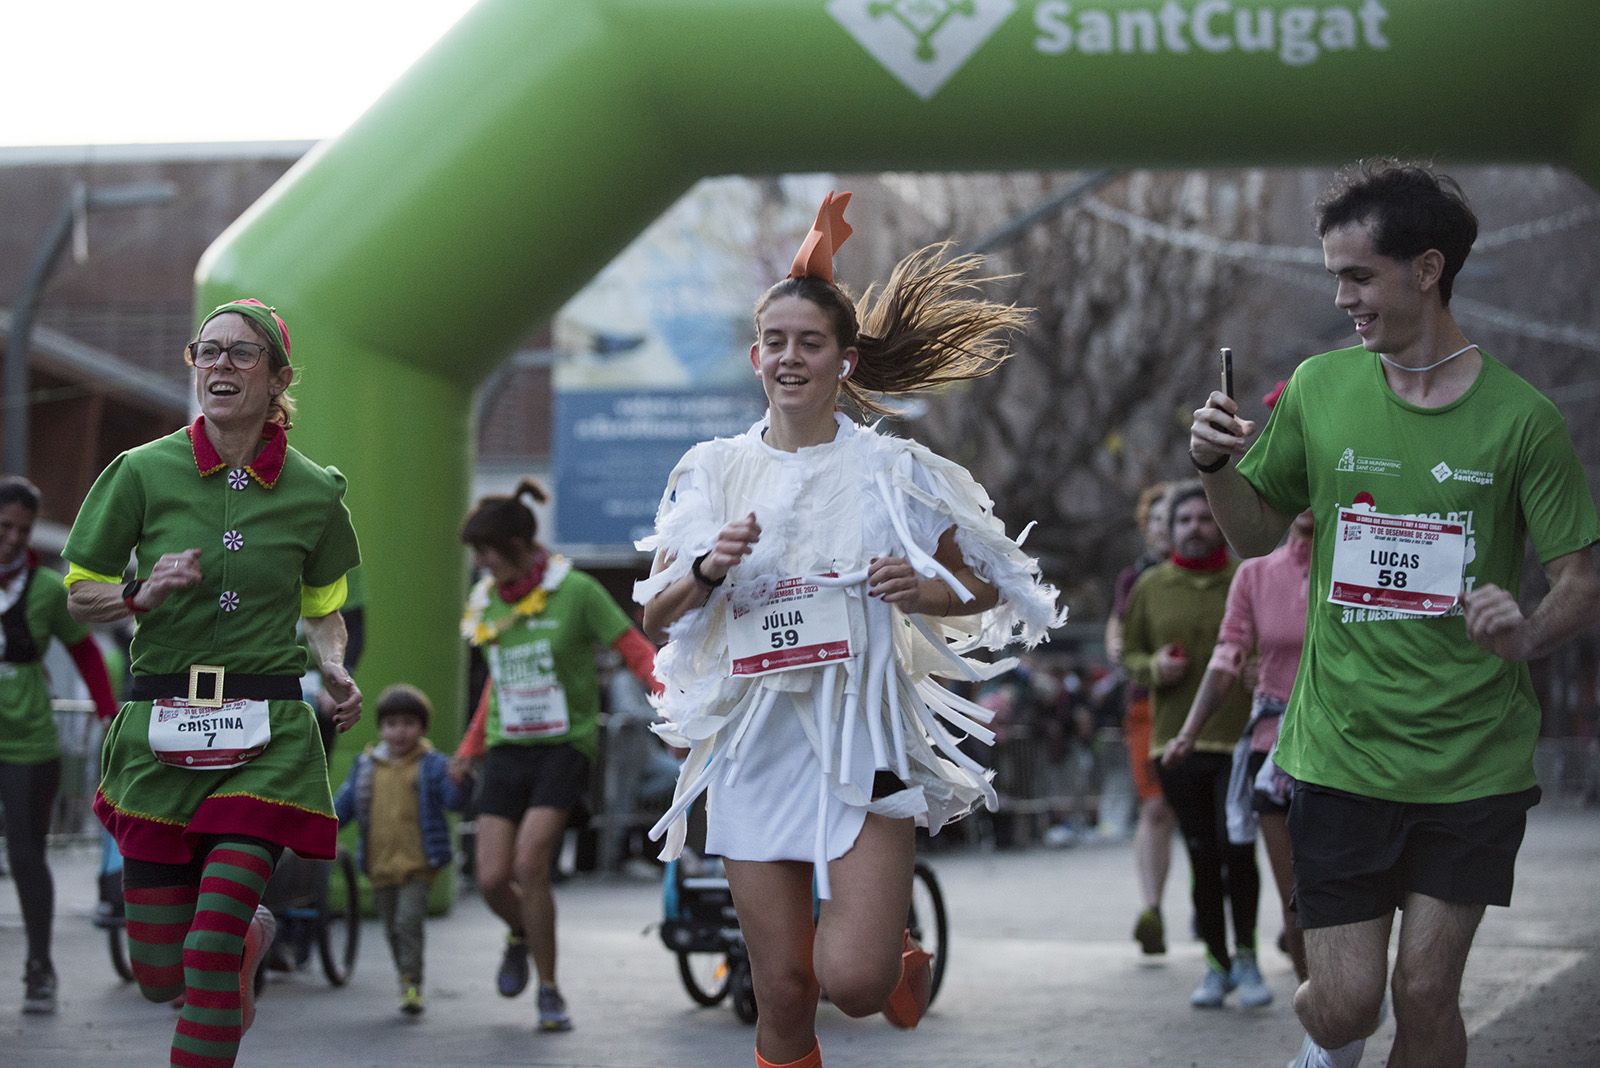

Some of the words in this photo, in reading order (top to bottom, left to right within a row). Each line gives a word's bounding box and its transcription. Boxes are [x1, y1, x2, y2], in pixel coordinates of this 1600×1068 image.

[1033, 0, 1389, 65] SantCugat
[1356, 458, 1369, 466] CLUB
[1453, 474, 1494, 485] SantCugat
[1454, 468, 1487, 477] AJUNTAMENT
[1385, 529, 1414, 538] DESEMBRE
[1415, 531, 1423, 539] DE
[1424, 532, 1440, 541] 2023
[1370, 549, 1420, 569] LUCAS
[1377, 569, 1407, 588] 58
[803, 585, 818, 594] 2023
[762, 611, 804, 630] JÚLIA
[1341, 609, 1353, 623] 31
[1355, 609, 1366, 622] DE
[1367, 608, 1423, 621] DESEM
[771, 629, 799, 649] 59
[178, 717, 244, 732] CRISTINA
[204, 732, 217, 748] 7
